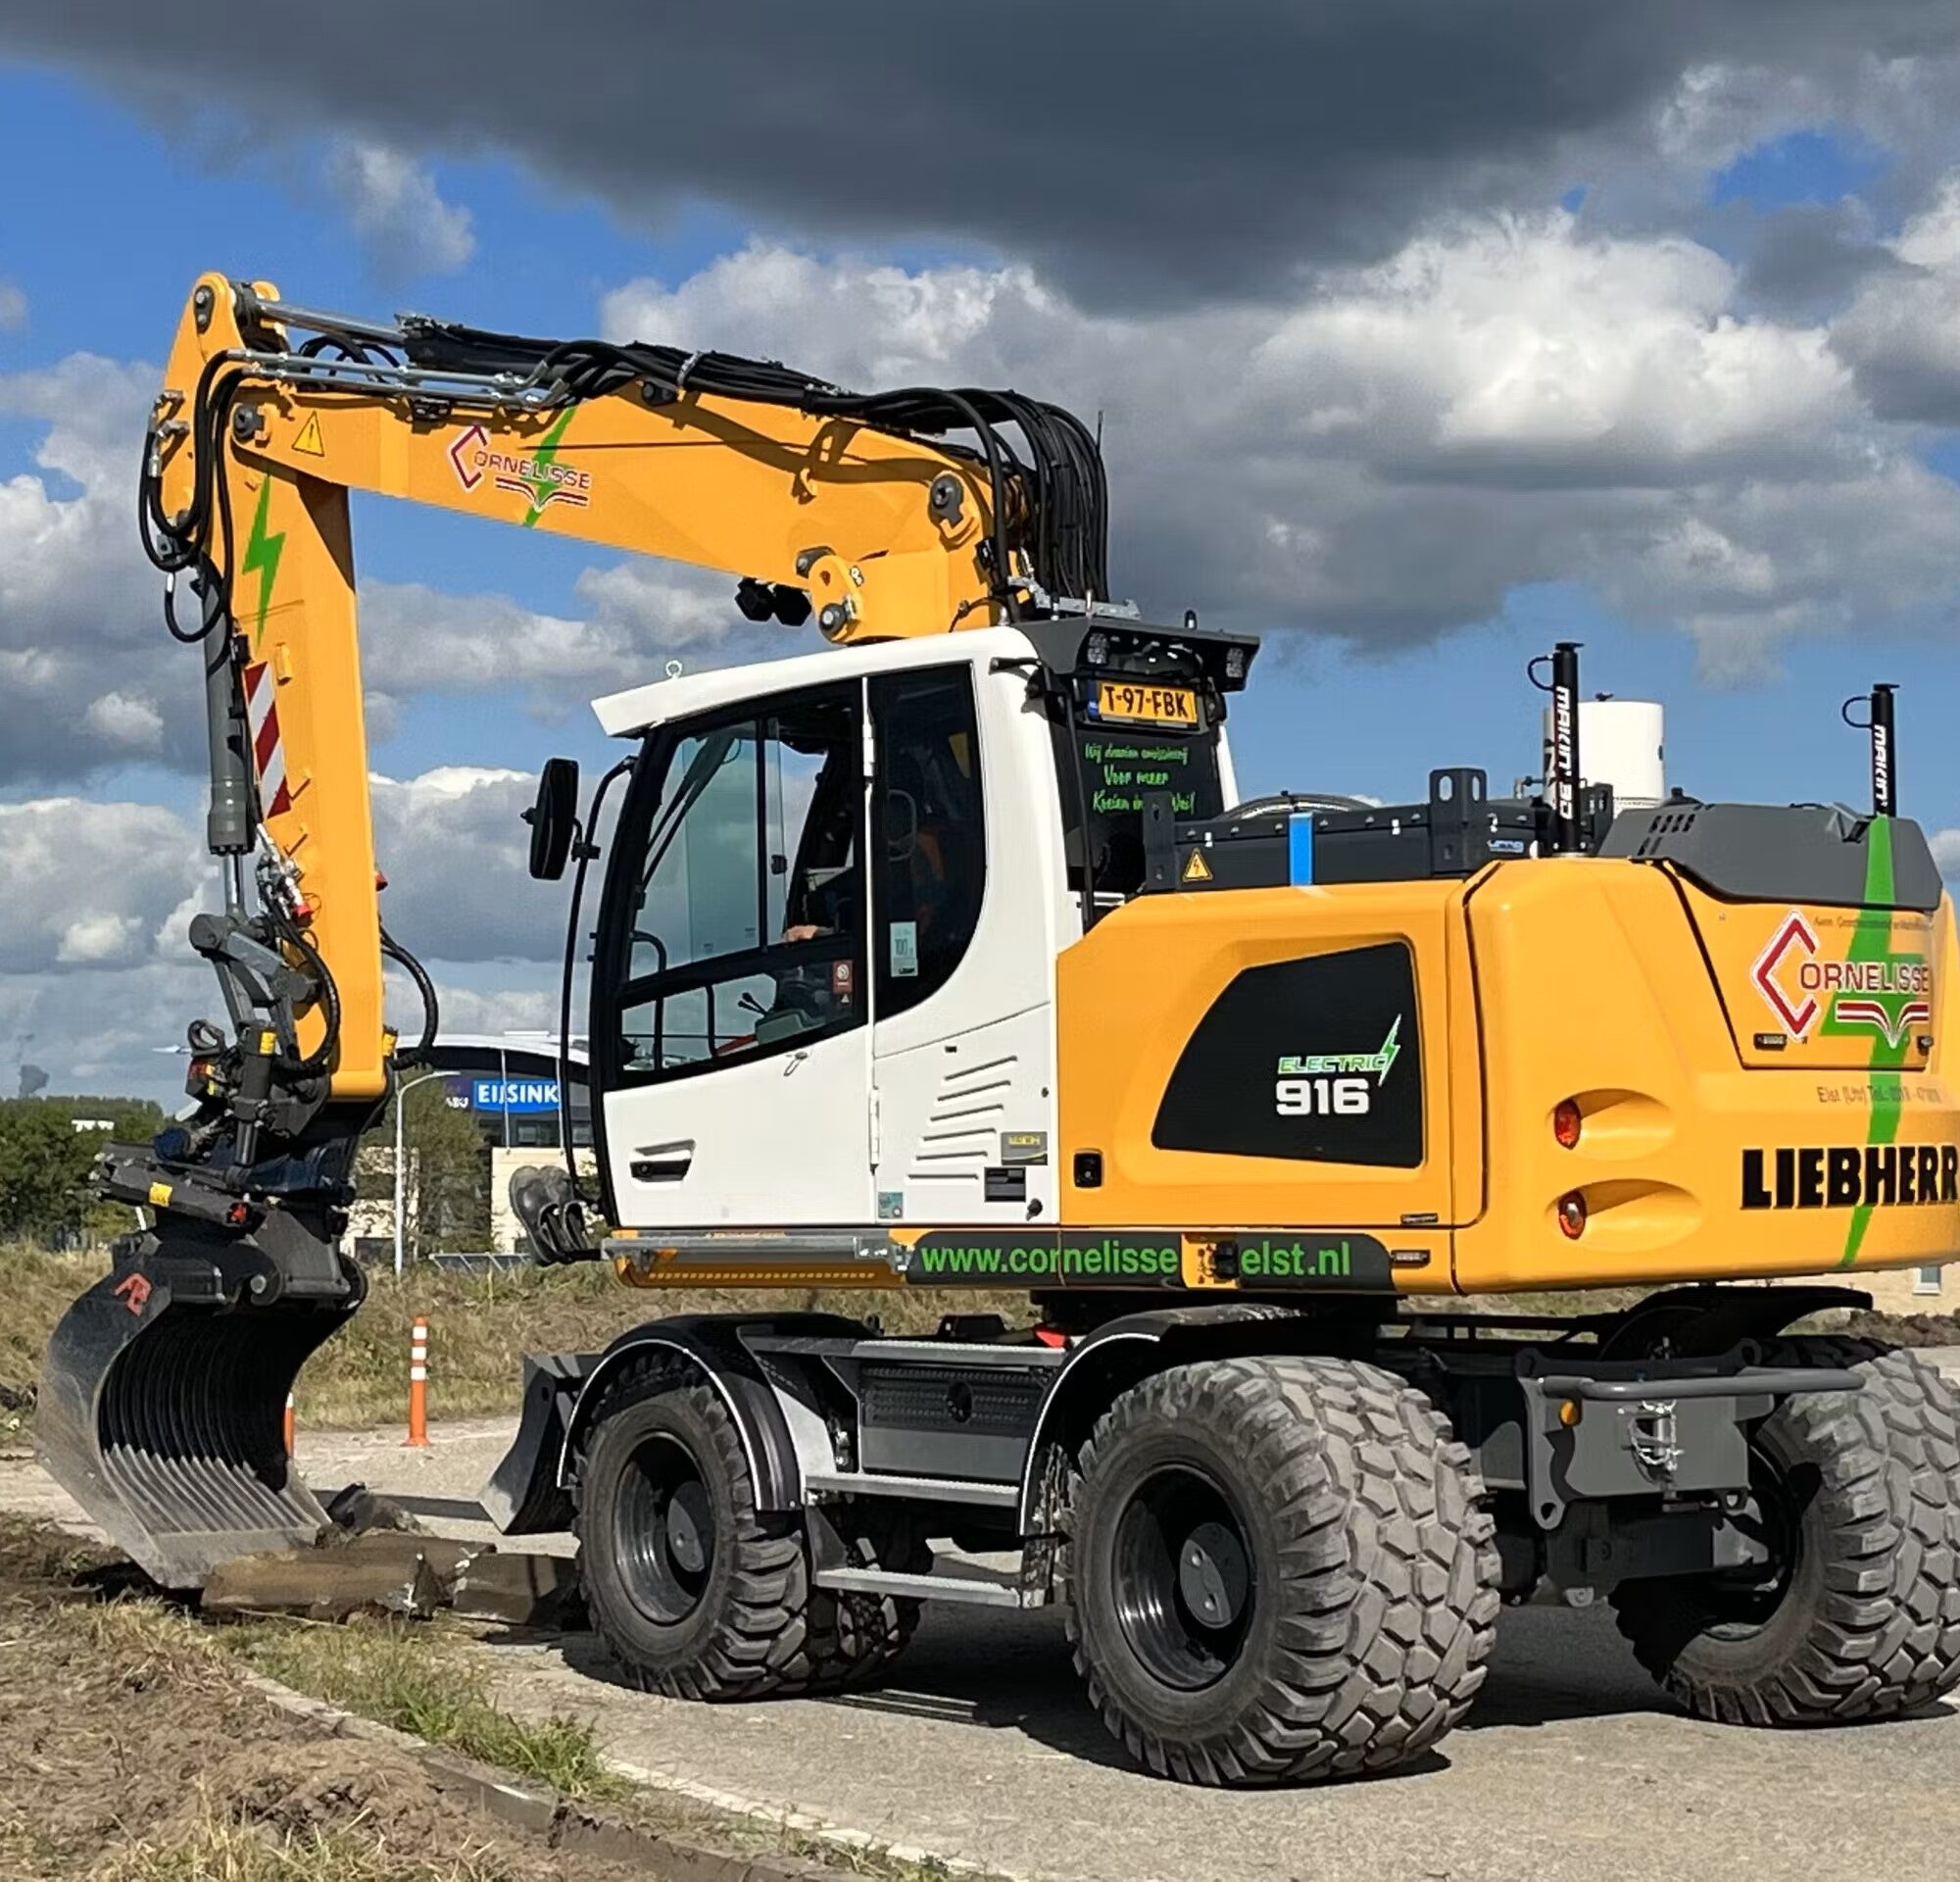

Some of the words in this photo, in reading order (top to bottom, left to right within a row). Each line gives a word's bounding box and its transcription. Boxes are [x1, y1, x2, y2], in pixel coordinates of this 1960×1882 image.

[450, 424, 590, 489] CORNELISSE
[1104, 685, 1188, 718] T-97-FBK
[1104, 765, 1132, 785] Voor
[1757, 918, 1929, 1035] CORNELISSE
[1278, 1054, 1389, 1074] ELECTRIC
[1276, 1079, 1369, 1114] 916
[1741, 1146, 1959, 1209] LIEBHERR
